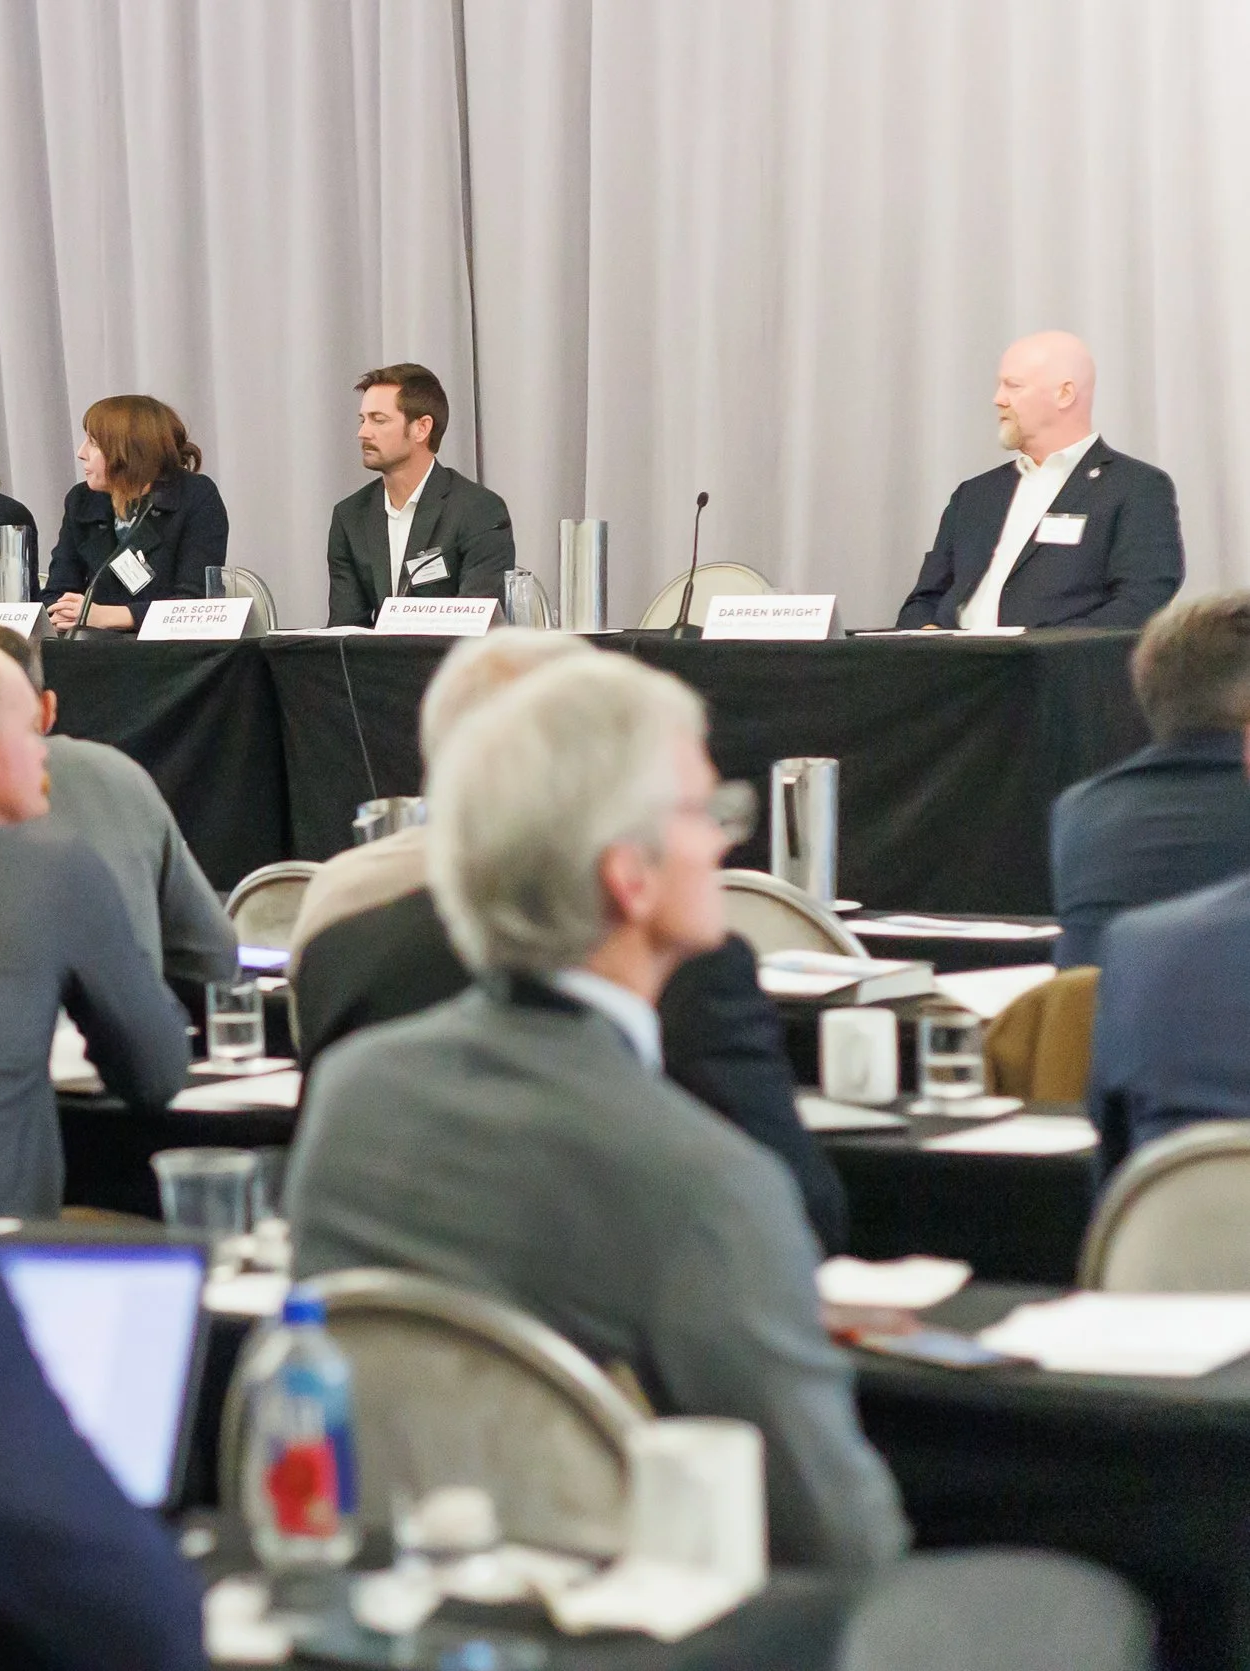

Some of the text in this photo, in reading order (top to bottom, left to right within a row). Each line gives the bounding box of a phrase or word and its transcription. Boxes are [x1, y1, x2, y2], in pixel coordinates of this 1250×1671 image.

[171, 605, 227, 614] DR. SCOTT
[389, 605, 485, 614] R. DAVID LEWALD
[718, 608, 822, 617] DARREN WRIGHT
[162, 614, 228, 624] BEATTY, PHD
